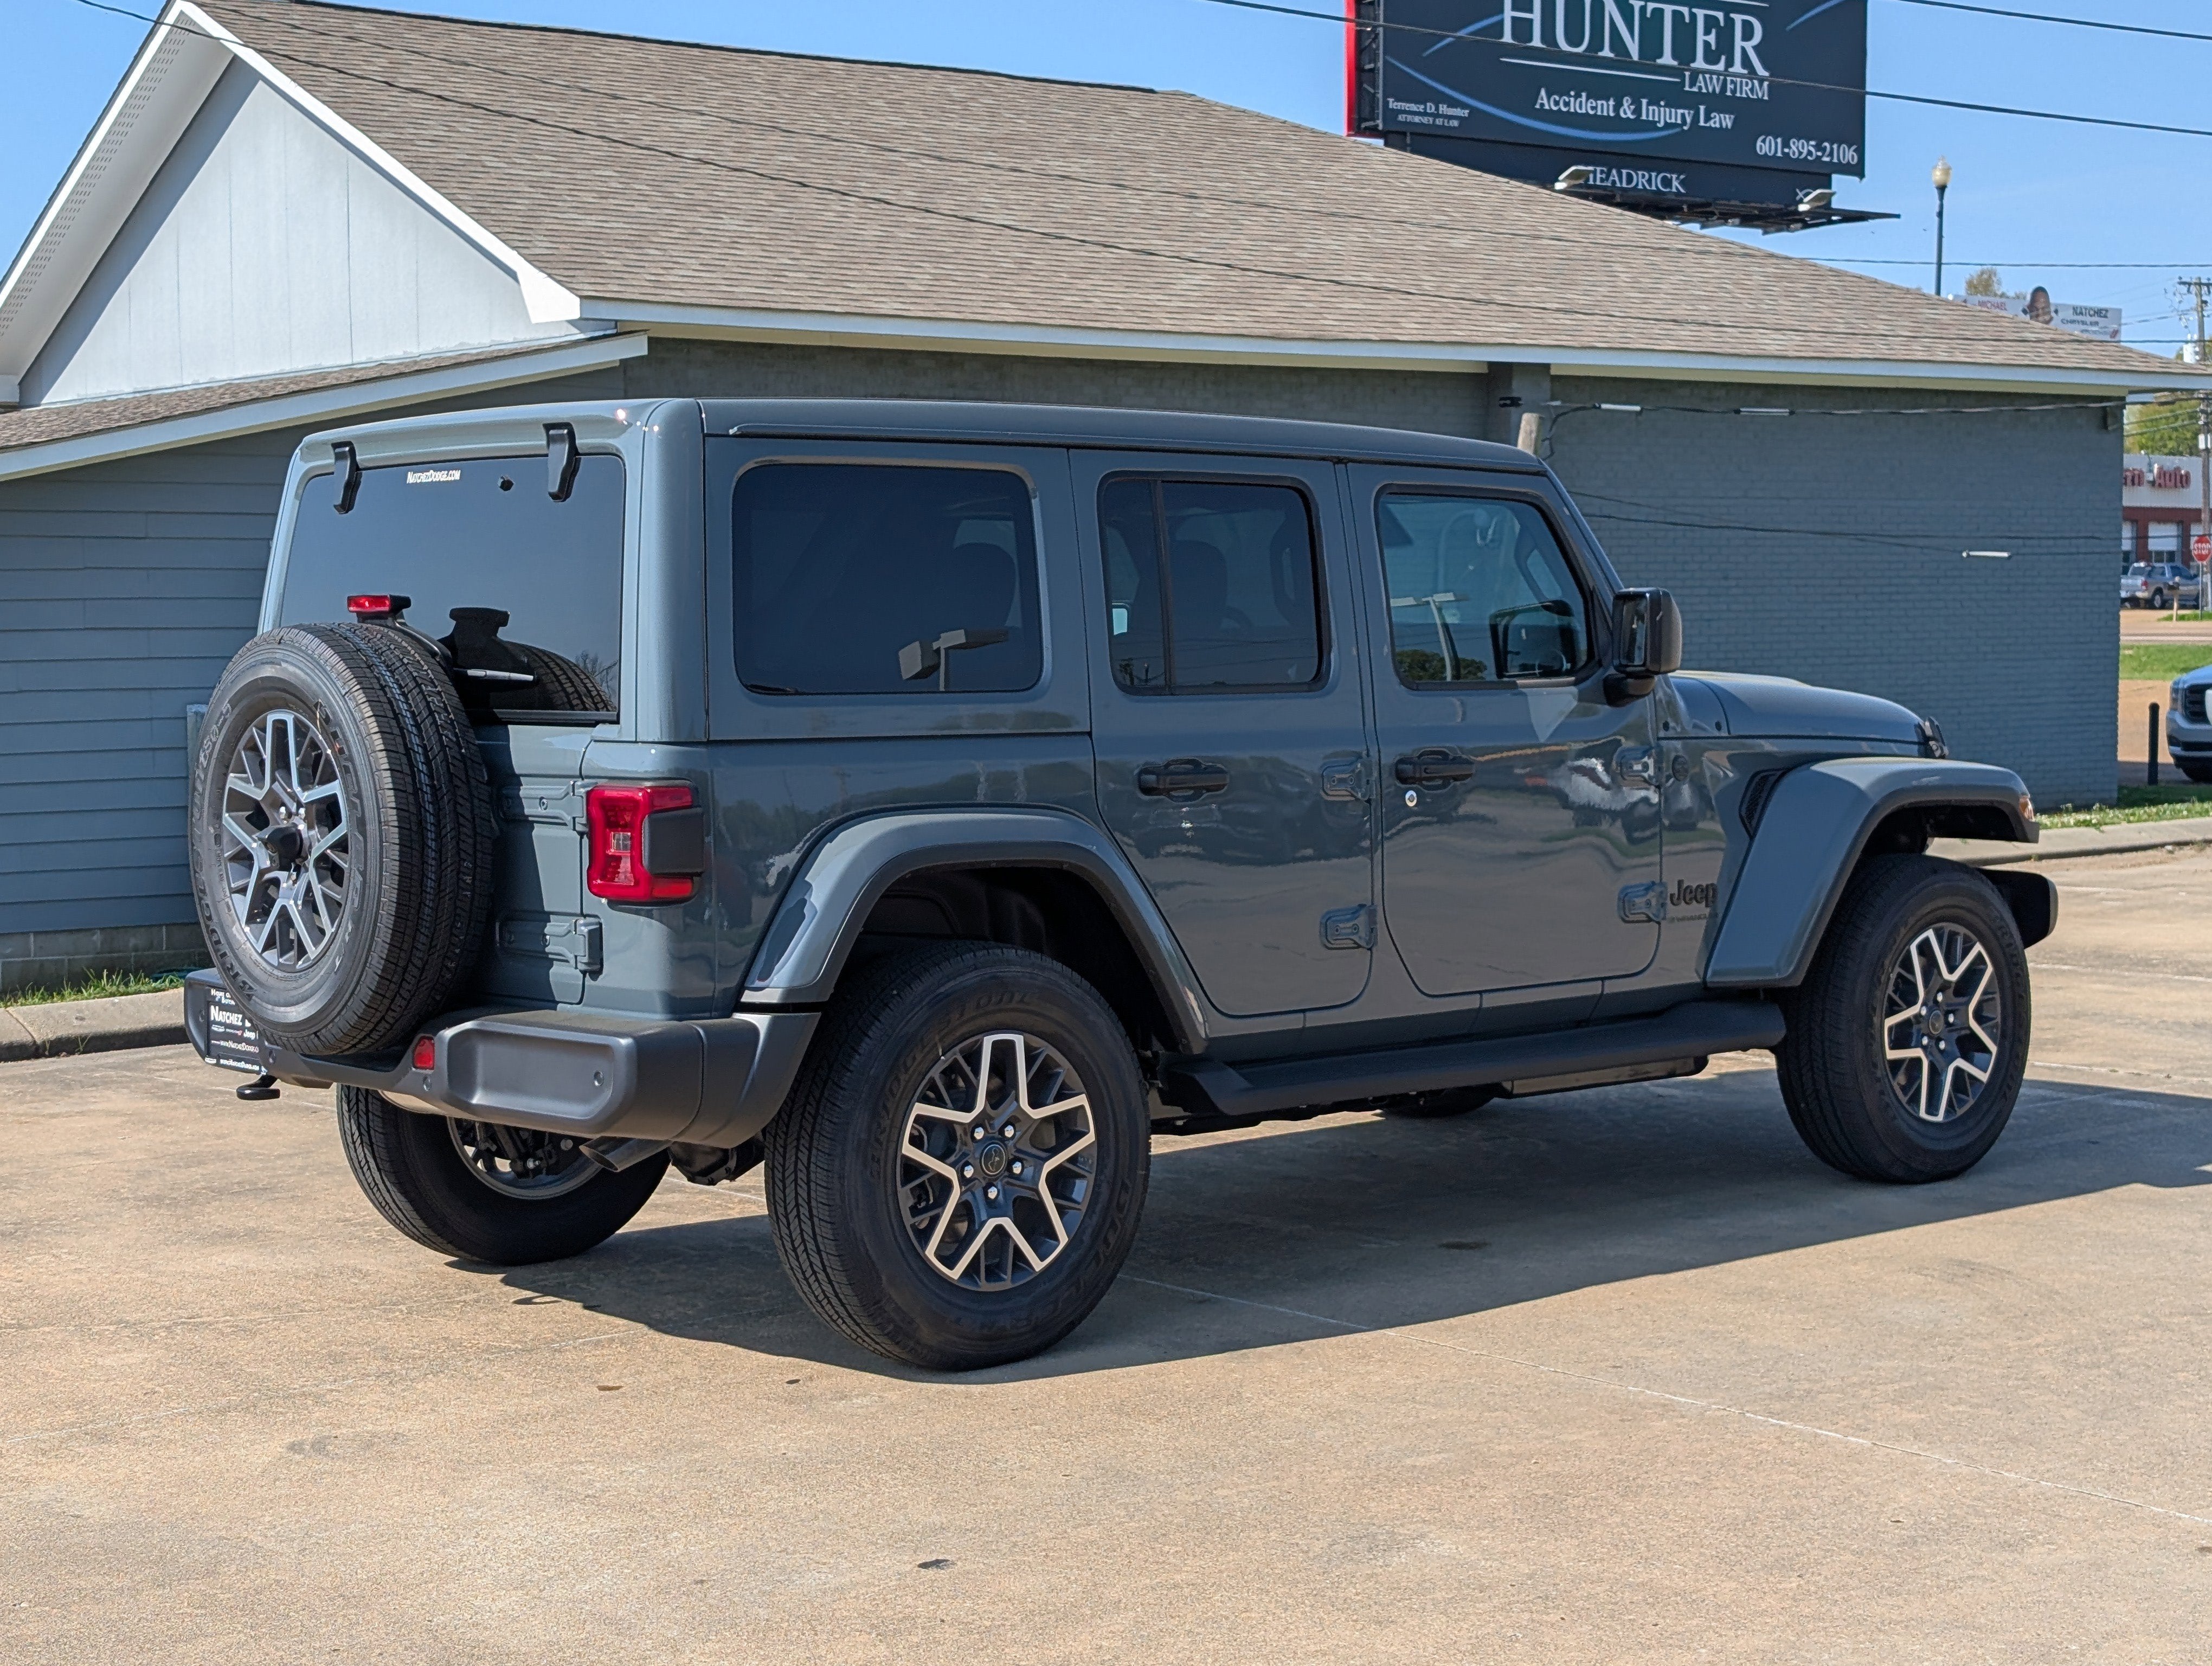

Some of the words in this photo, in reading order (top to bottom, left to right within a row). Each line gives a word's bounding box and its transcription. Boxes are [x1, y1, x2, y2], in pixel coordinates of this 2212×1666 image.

[1501, 0, 1770, 76] HUNTER
[1683, 72, 1725, 94] LAW
[1725, 76, 1770, 100] FIRM
[1426, 102, 1437, 113] D.
[1439, 104, 1470, 117] Hunter
[1535, 88, 1616, 117] Accident
[1619, 97, 1637, 119] &
[1640, 99, 1694, 130] Injury
[1699, 105, 1735, 129] Law
[1756, 136, 1858, 165] 601-895-2106
[2072, 306, 2108, 318] NATCHEZ
[1669, 879, 1718, 907] Jeep
[210, 1005, 242, 1026] NATCHEZ
